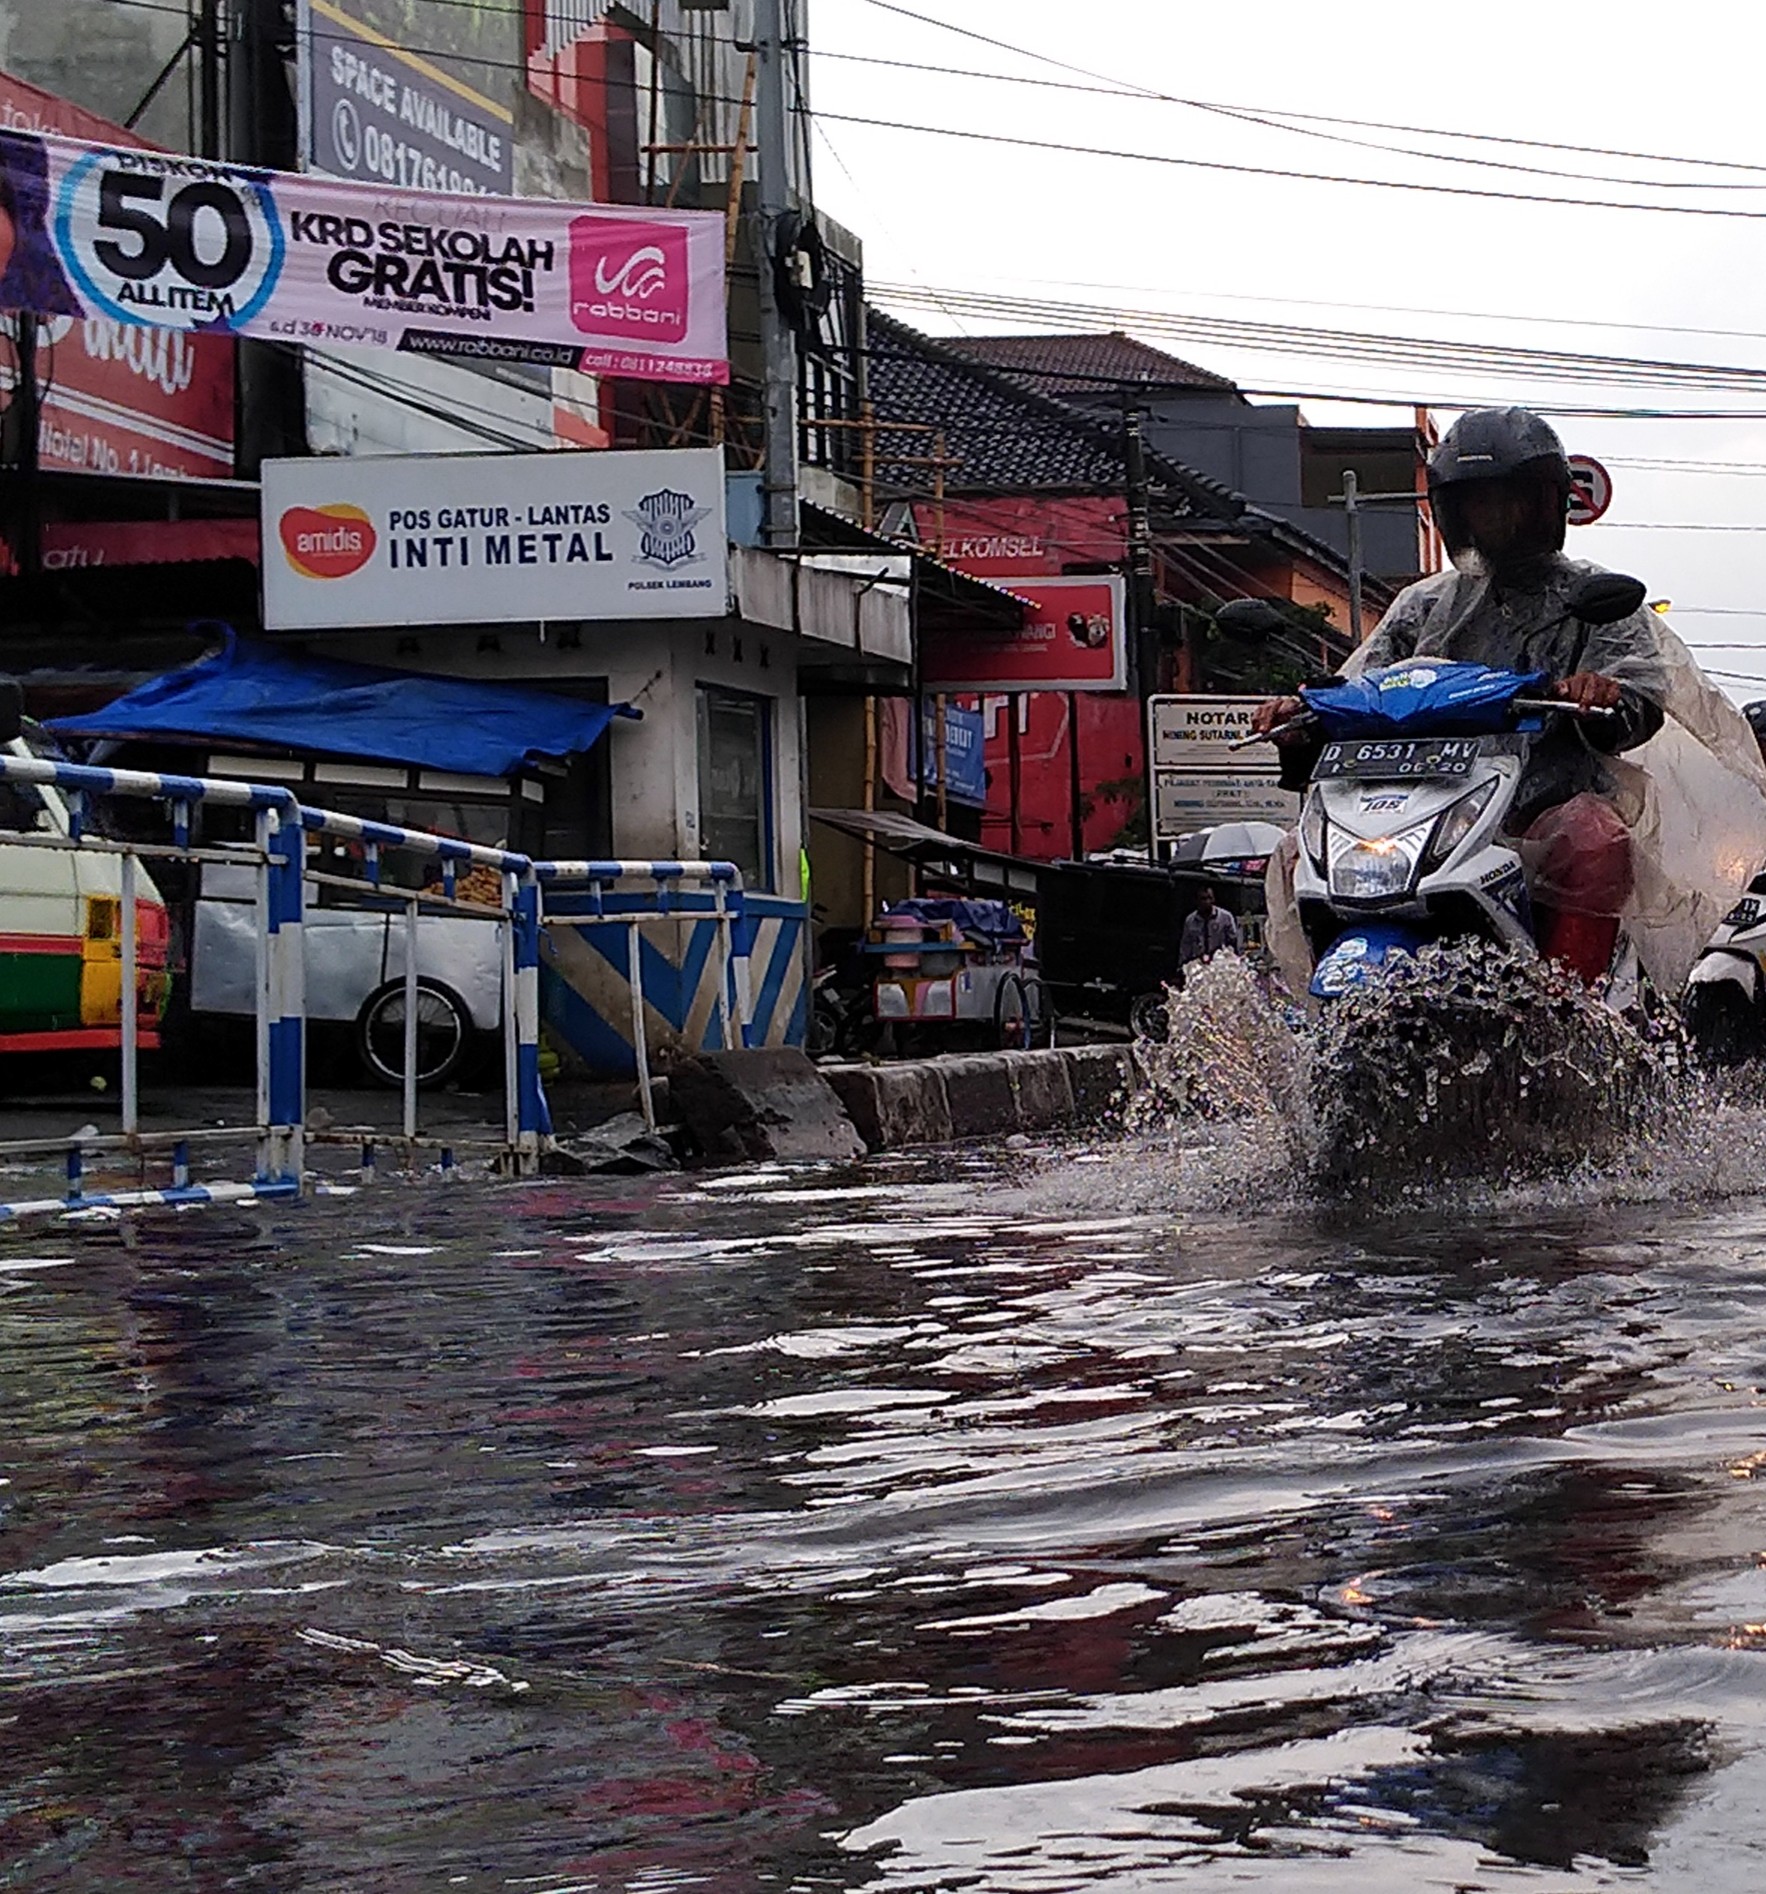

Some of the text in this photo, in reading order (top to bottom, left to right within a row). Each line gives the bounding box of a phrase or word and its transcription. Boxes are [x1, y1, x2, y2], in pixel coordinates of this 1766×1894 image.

[331, 45, 501, 173] SPACE AVAILABLE
[291, 211, 554, 272] KRD SEKOLAH
[327, 249, 536, 312] GRATIS!
[117, 282, 236, 318] ALL ITEM
[573, 302, 681, 325] rabbani
[408, 335, 573, 364] www.rabbani.co.id
[389, 511, 430, 530] POS
[437, 507, 509, 529] GATUR
[528, 503, 611, 526] LANTAS
[297, 526, 362, 552] amidis
[390, 531, 613, 568] INTI METAL
[628, 578, 712, 590] POLSEK LEMBANG
[1324, 742, 1476, 761] D 6531 MV
[1480, 860, 1516, 885] HONDA
